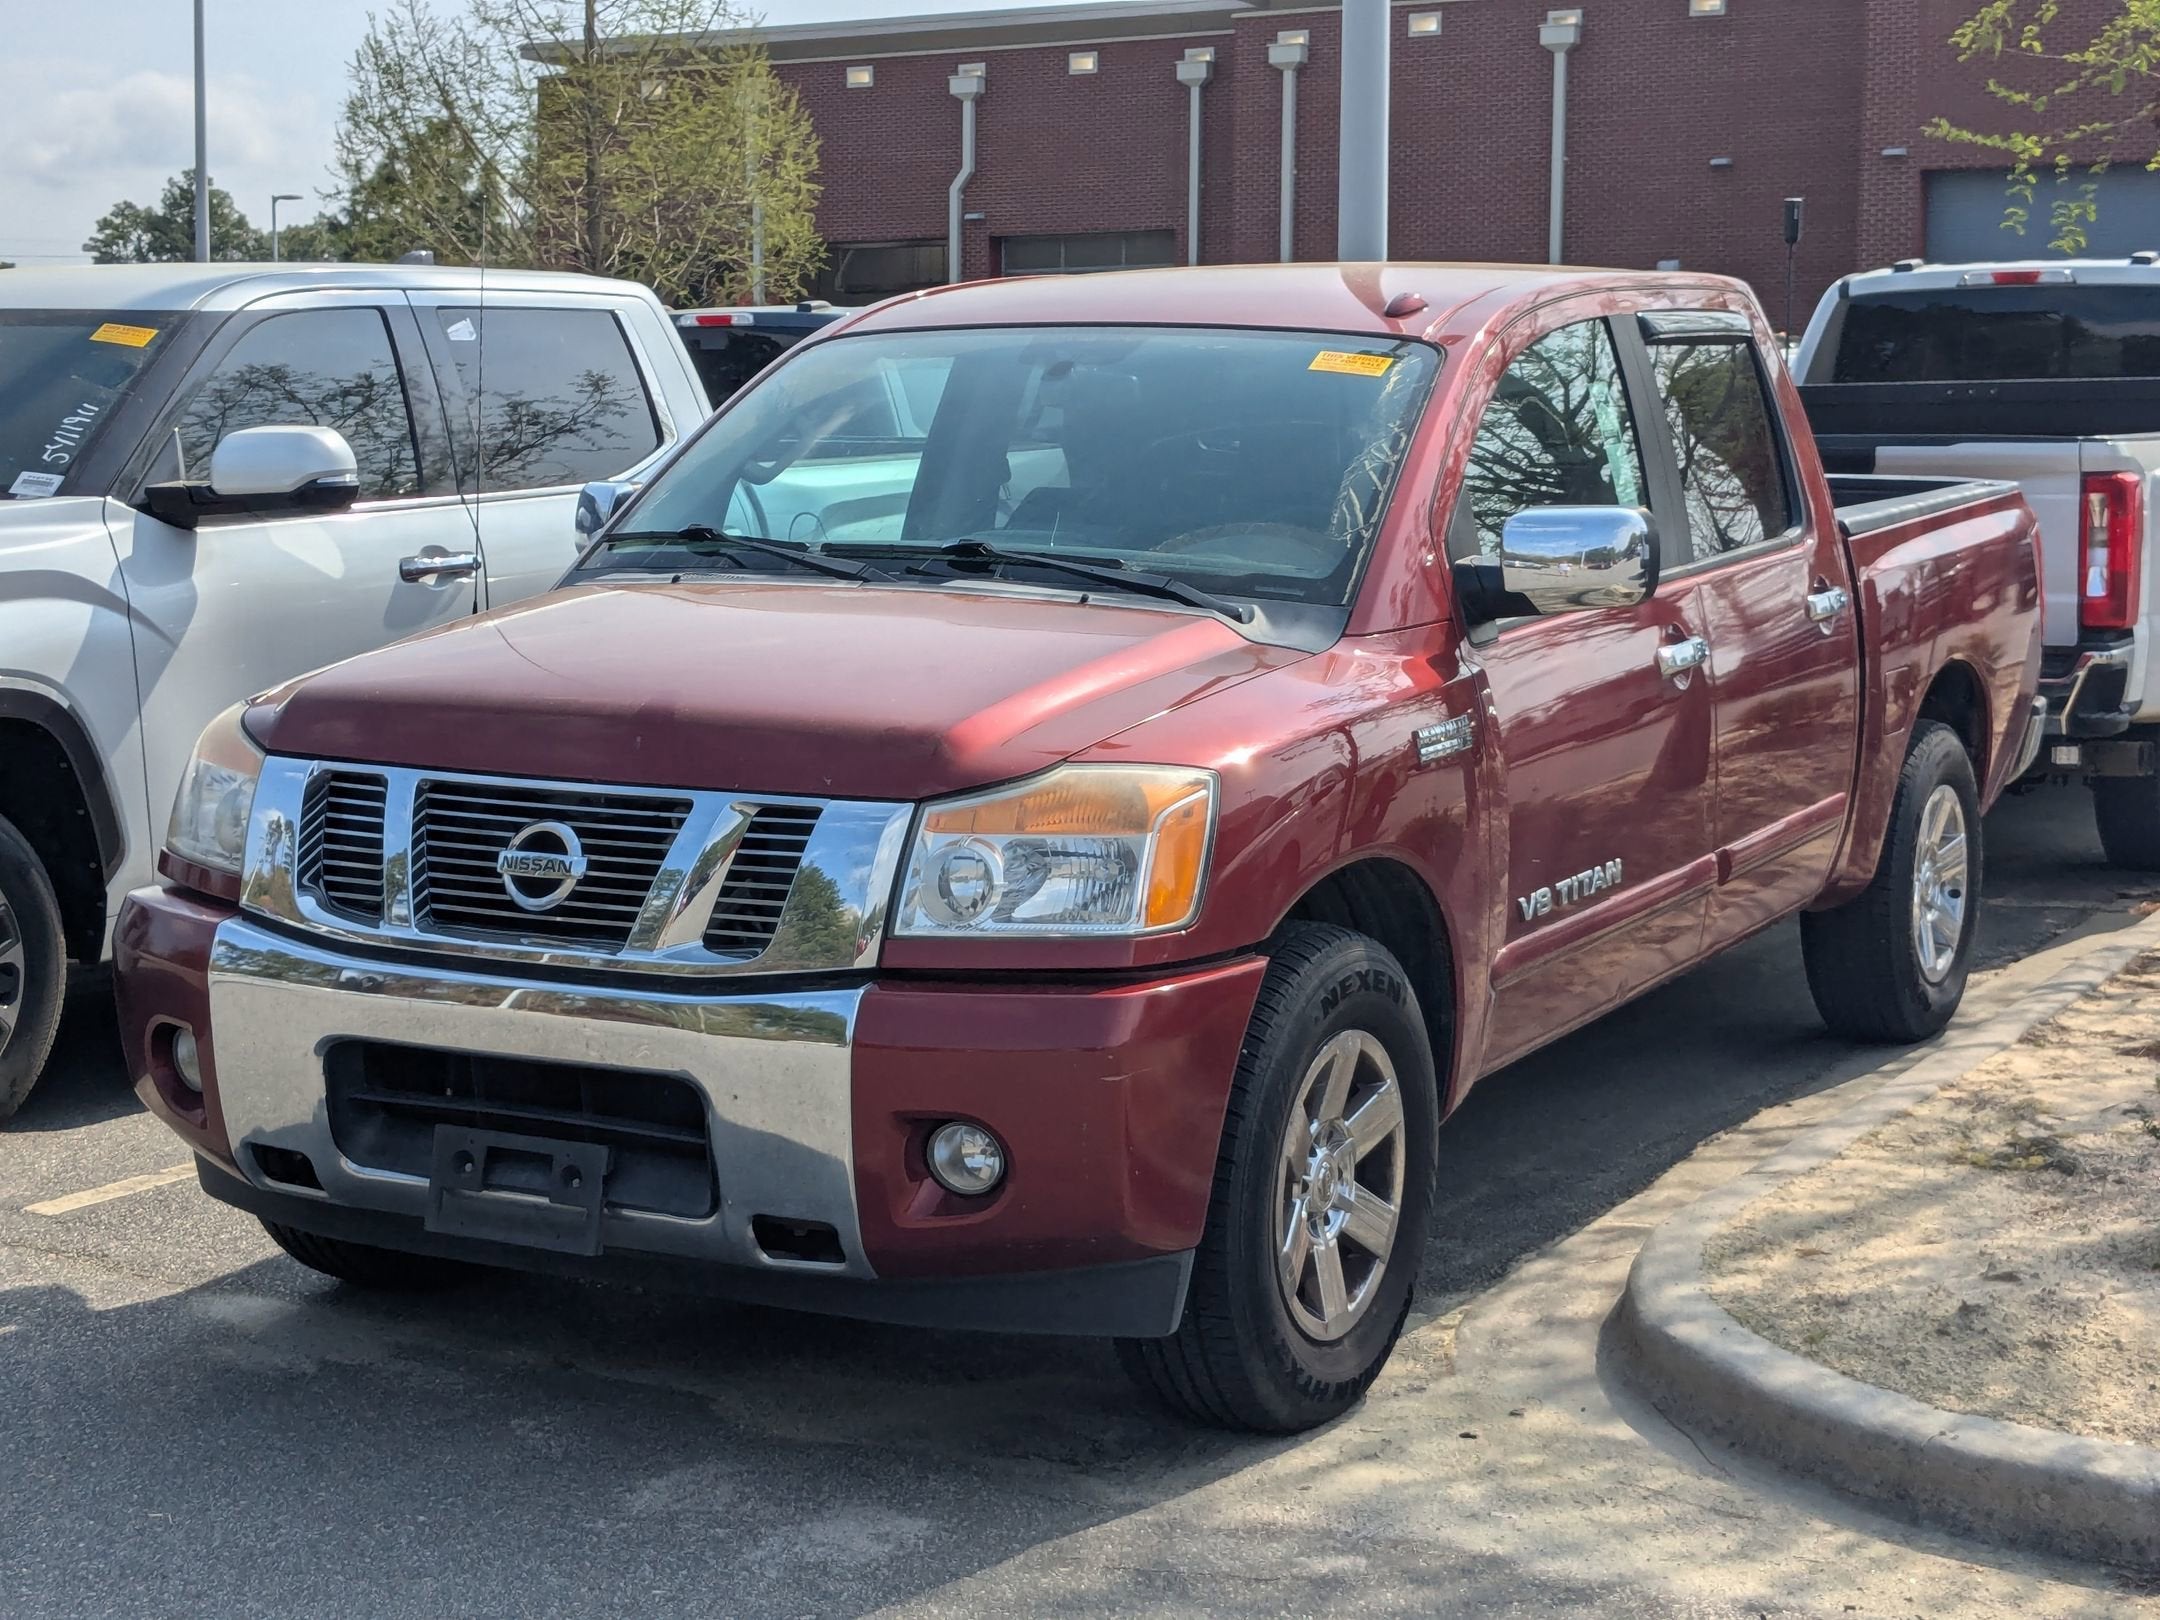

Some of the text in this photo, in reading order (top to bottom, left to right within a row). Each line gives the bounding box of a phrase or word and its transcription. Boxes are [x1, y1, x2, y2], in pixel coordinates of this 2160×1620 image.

[502, 855, 573, 874] NISSAN
[1517, 857, 1622, 921] V8 TITAN
[1320, 969, 1402, 1020] NEXEN
